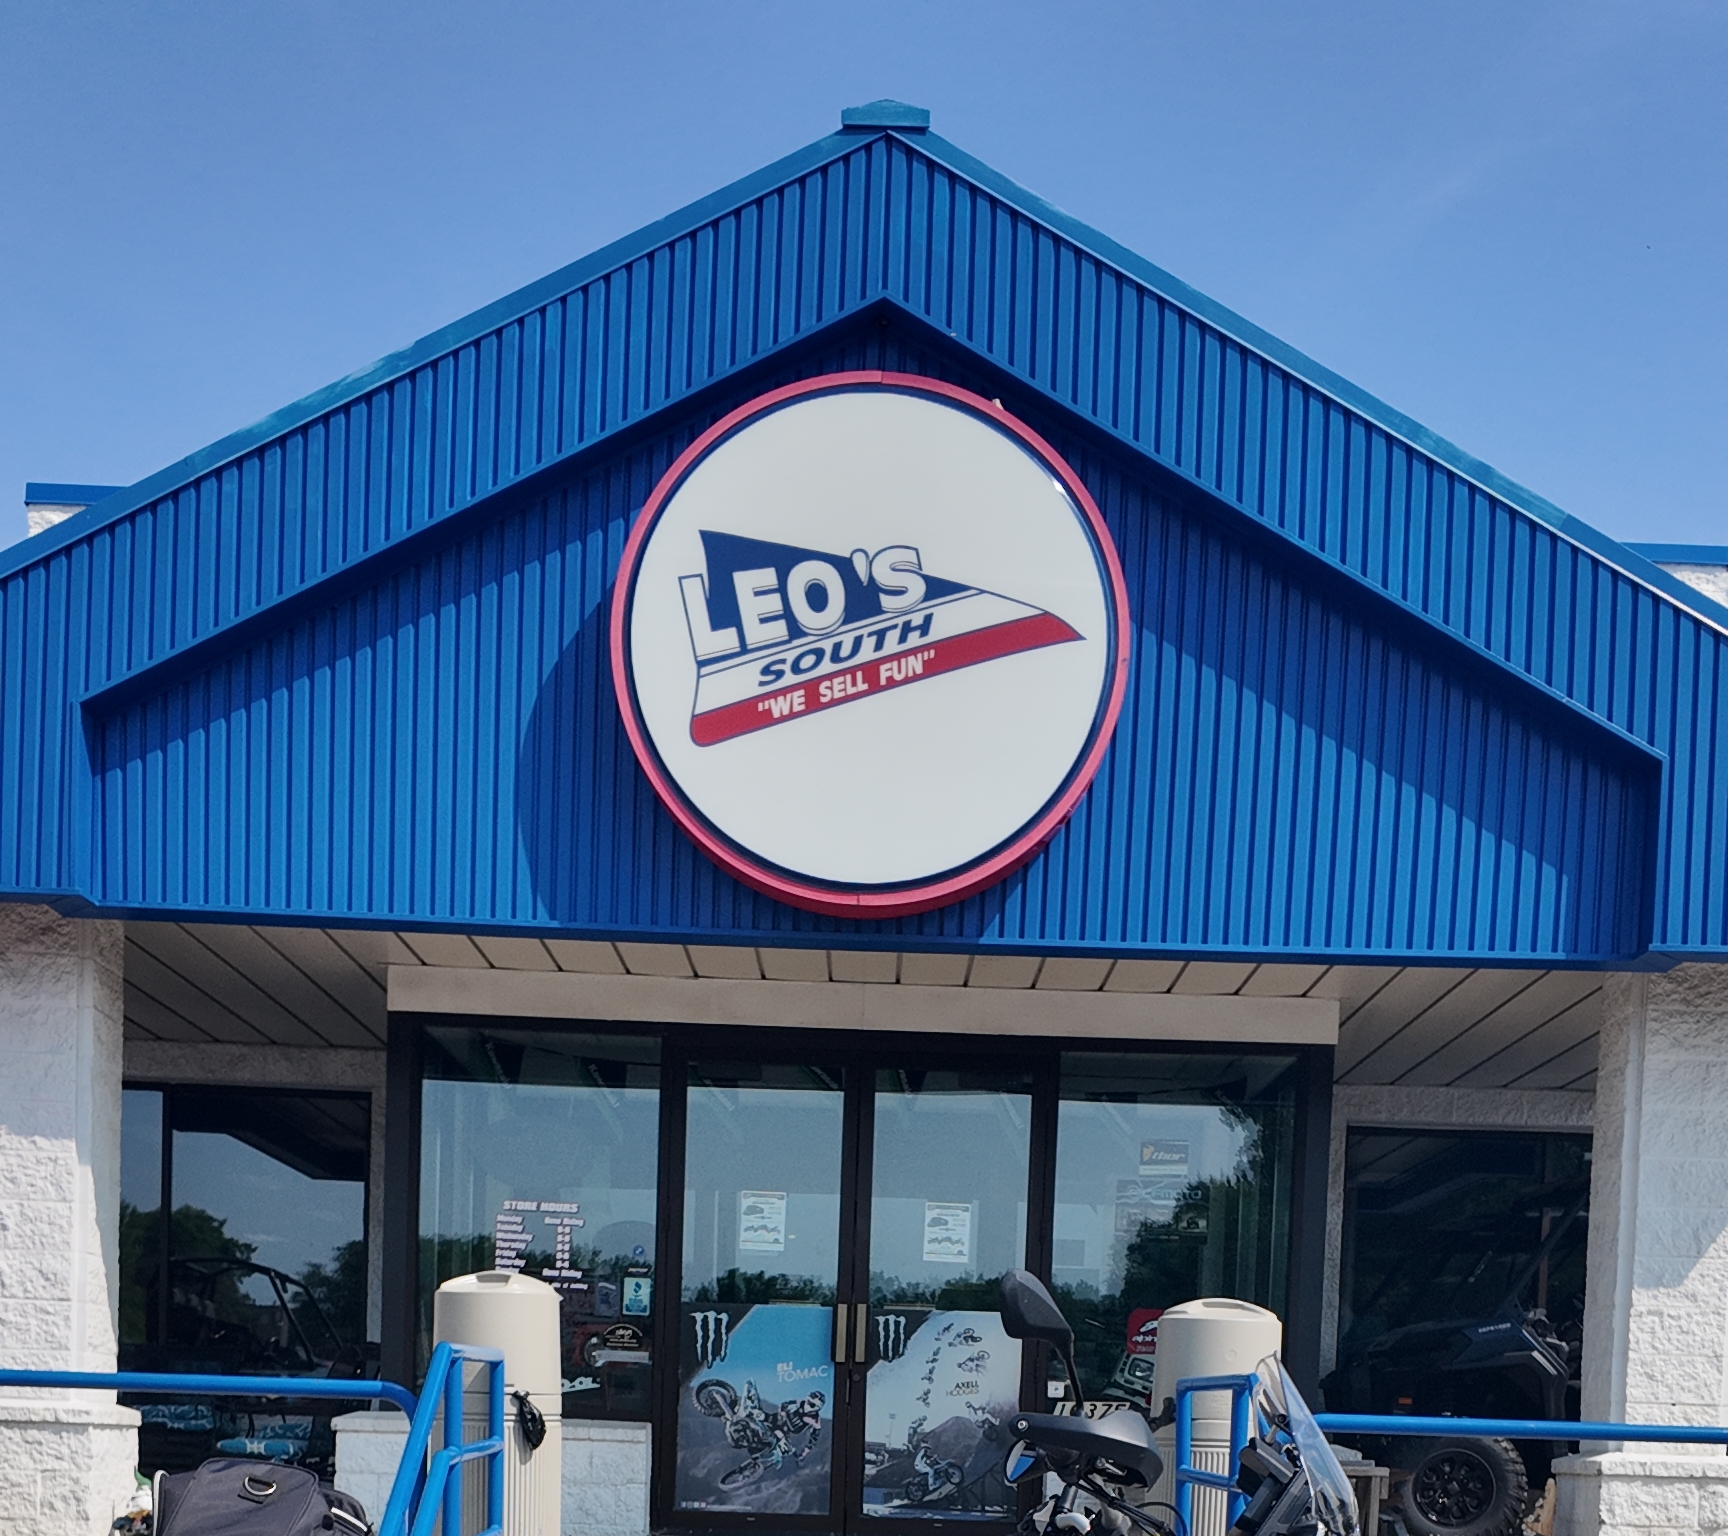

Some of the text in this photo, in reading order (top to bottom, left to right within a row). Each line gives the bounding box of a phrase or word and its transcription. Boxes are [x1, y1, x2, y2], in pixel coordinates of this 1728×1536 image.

[678, 545, 927, 662] LEO'S
[757, 648, 935, 719] "WE SELL FUN"
[758, 612, 934, 687] SOUTH
[503, 1200, 579, 1213] STORE HOURS
[777, 1365, 829, 1382] TOMAC
